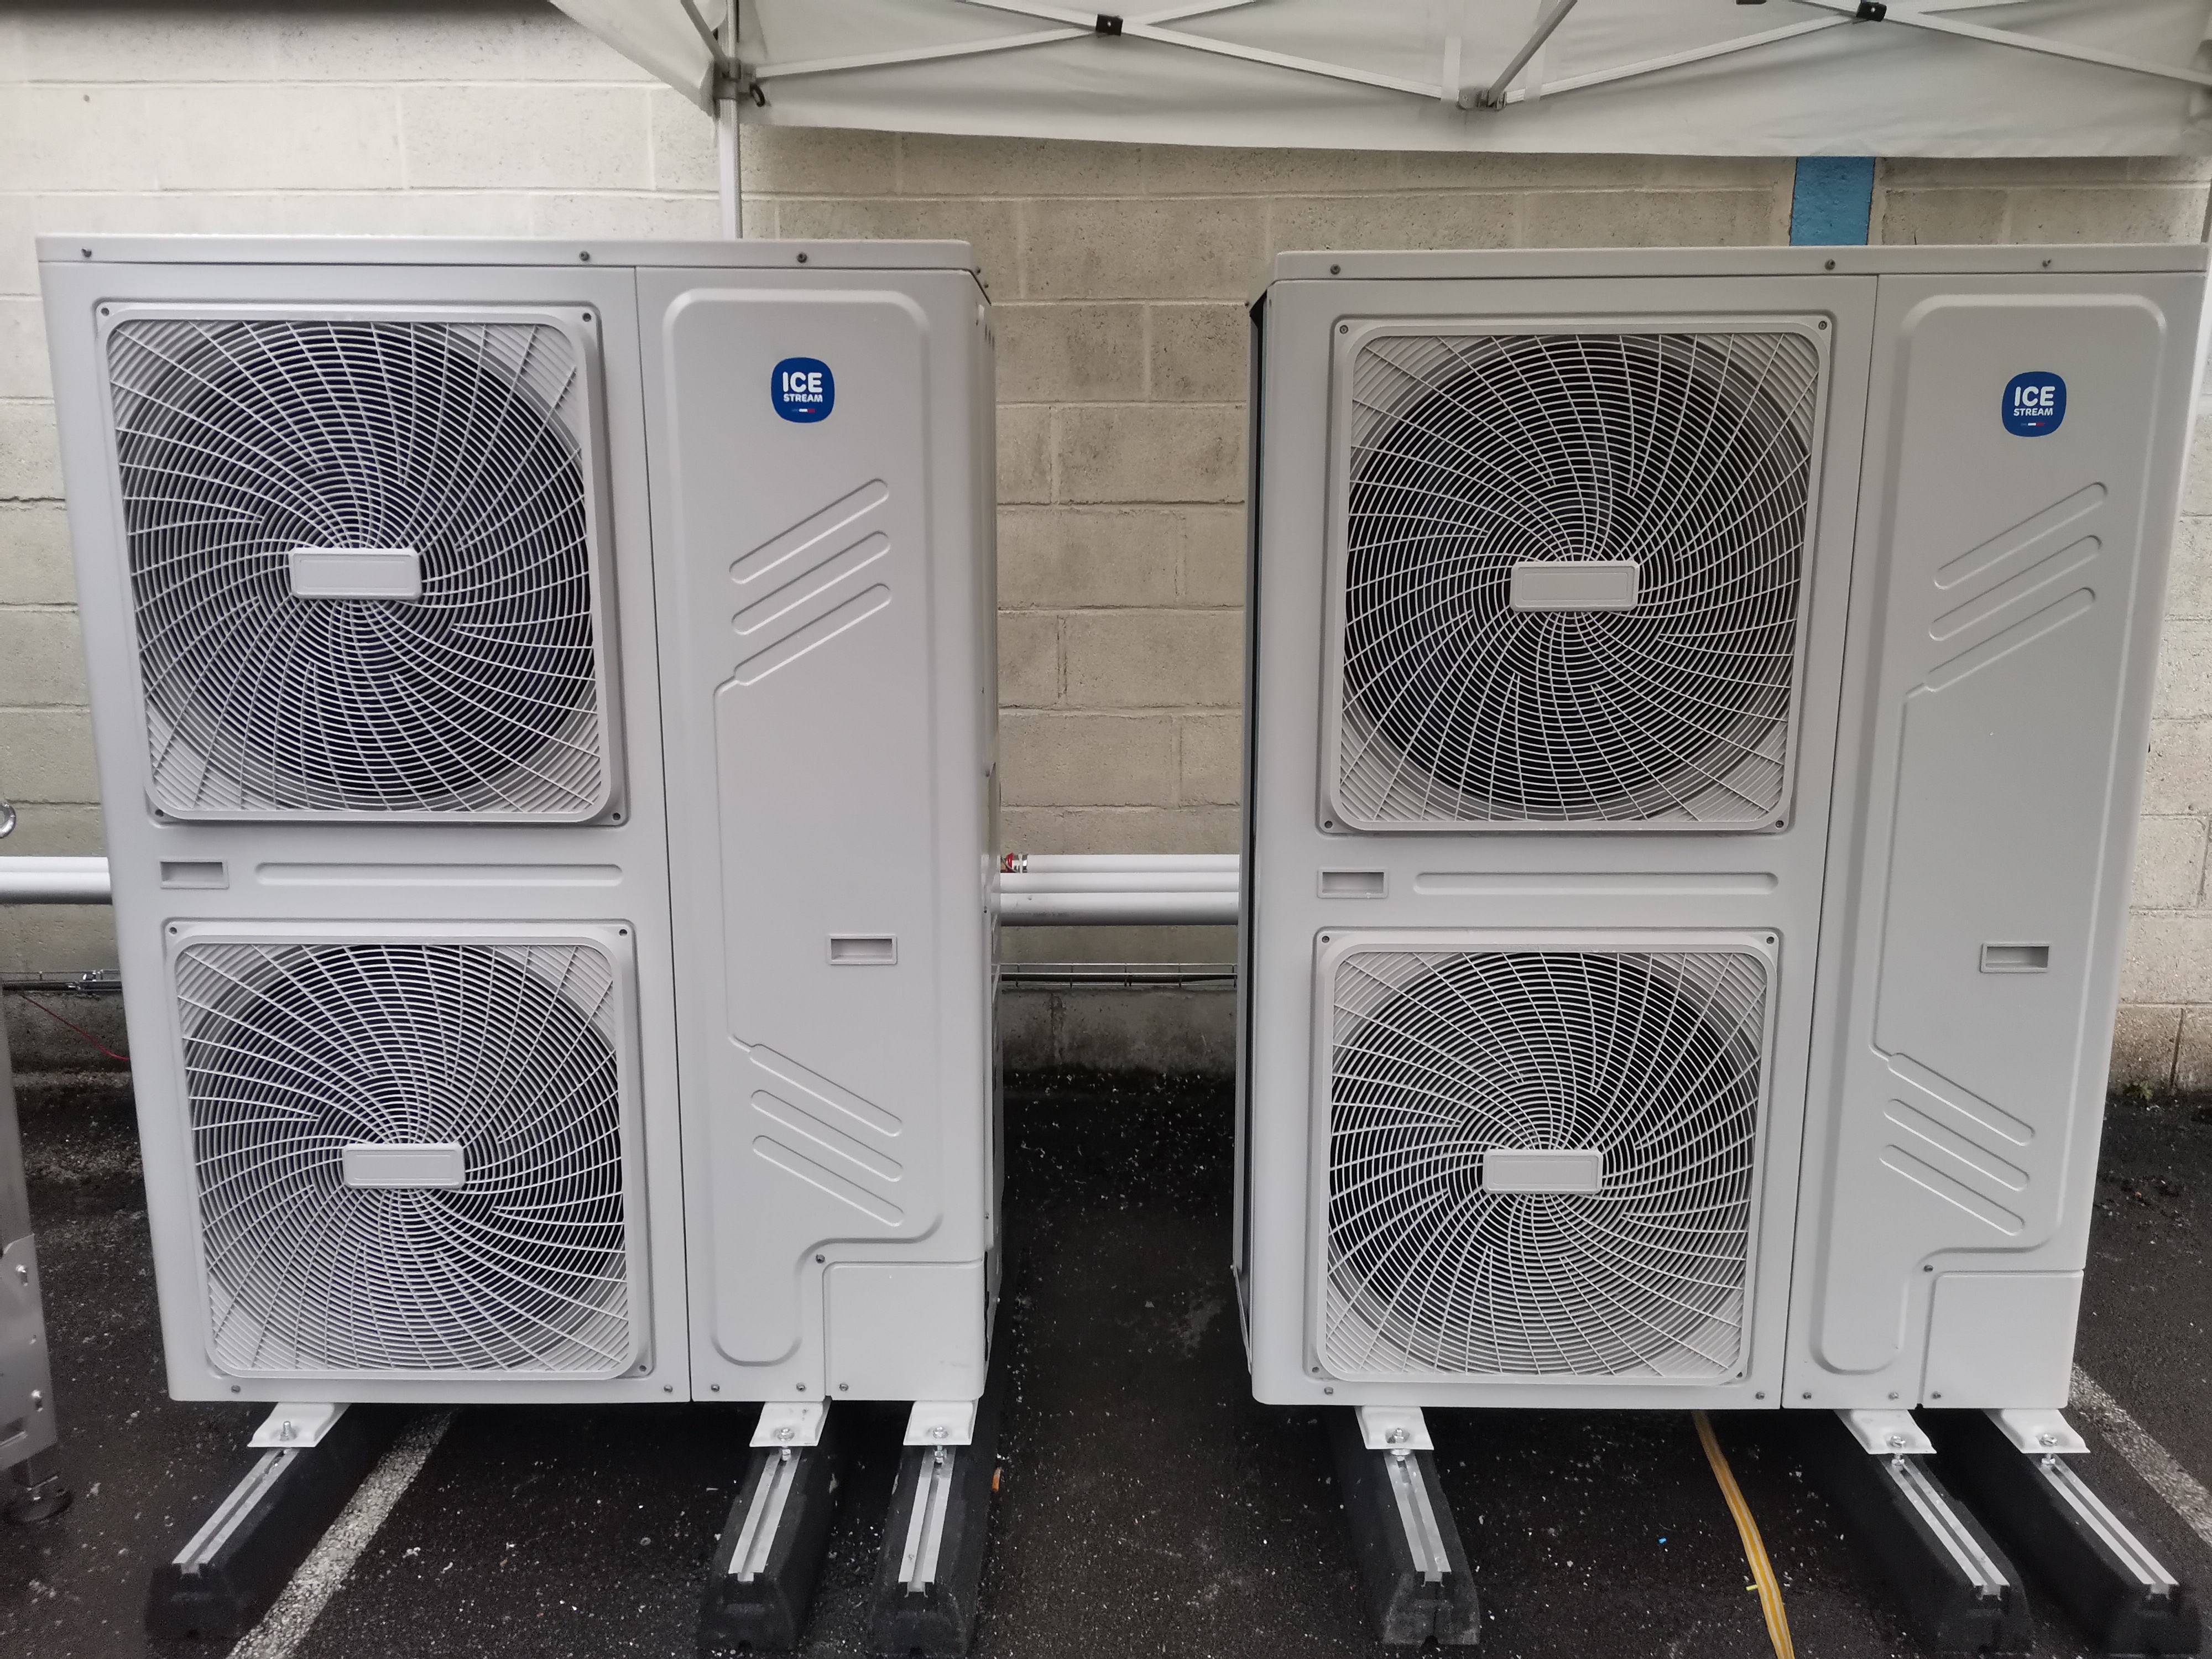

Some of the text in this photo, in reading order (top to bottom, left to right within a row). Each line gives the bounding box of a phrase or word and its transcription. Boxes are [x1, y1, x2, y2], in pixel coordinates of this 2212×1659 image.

[782, 372, 822, 393] ICE
[784, 393, 822, 403] STREAM
[2015, 387, 2056, 406] ICE
[2013, 408, 2053, 416] STREAM
